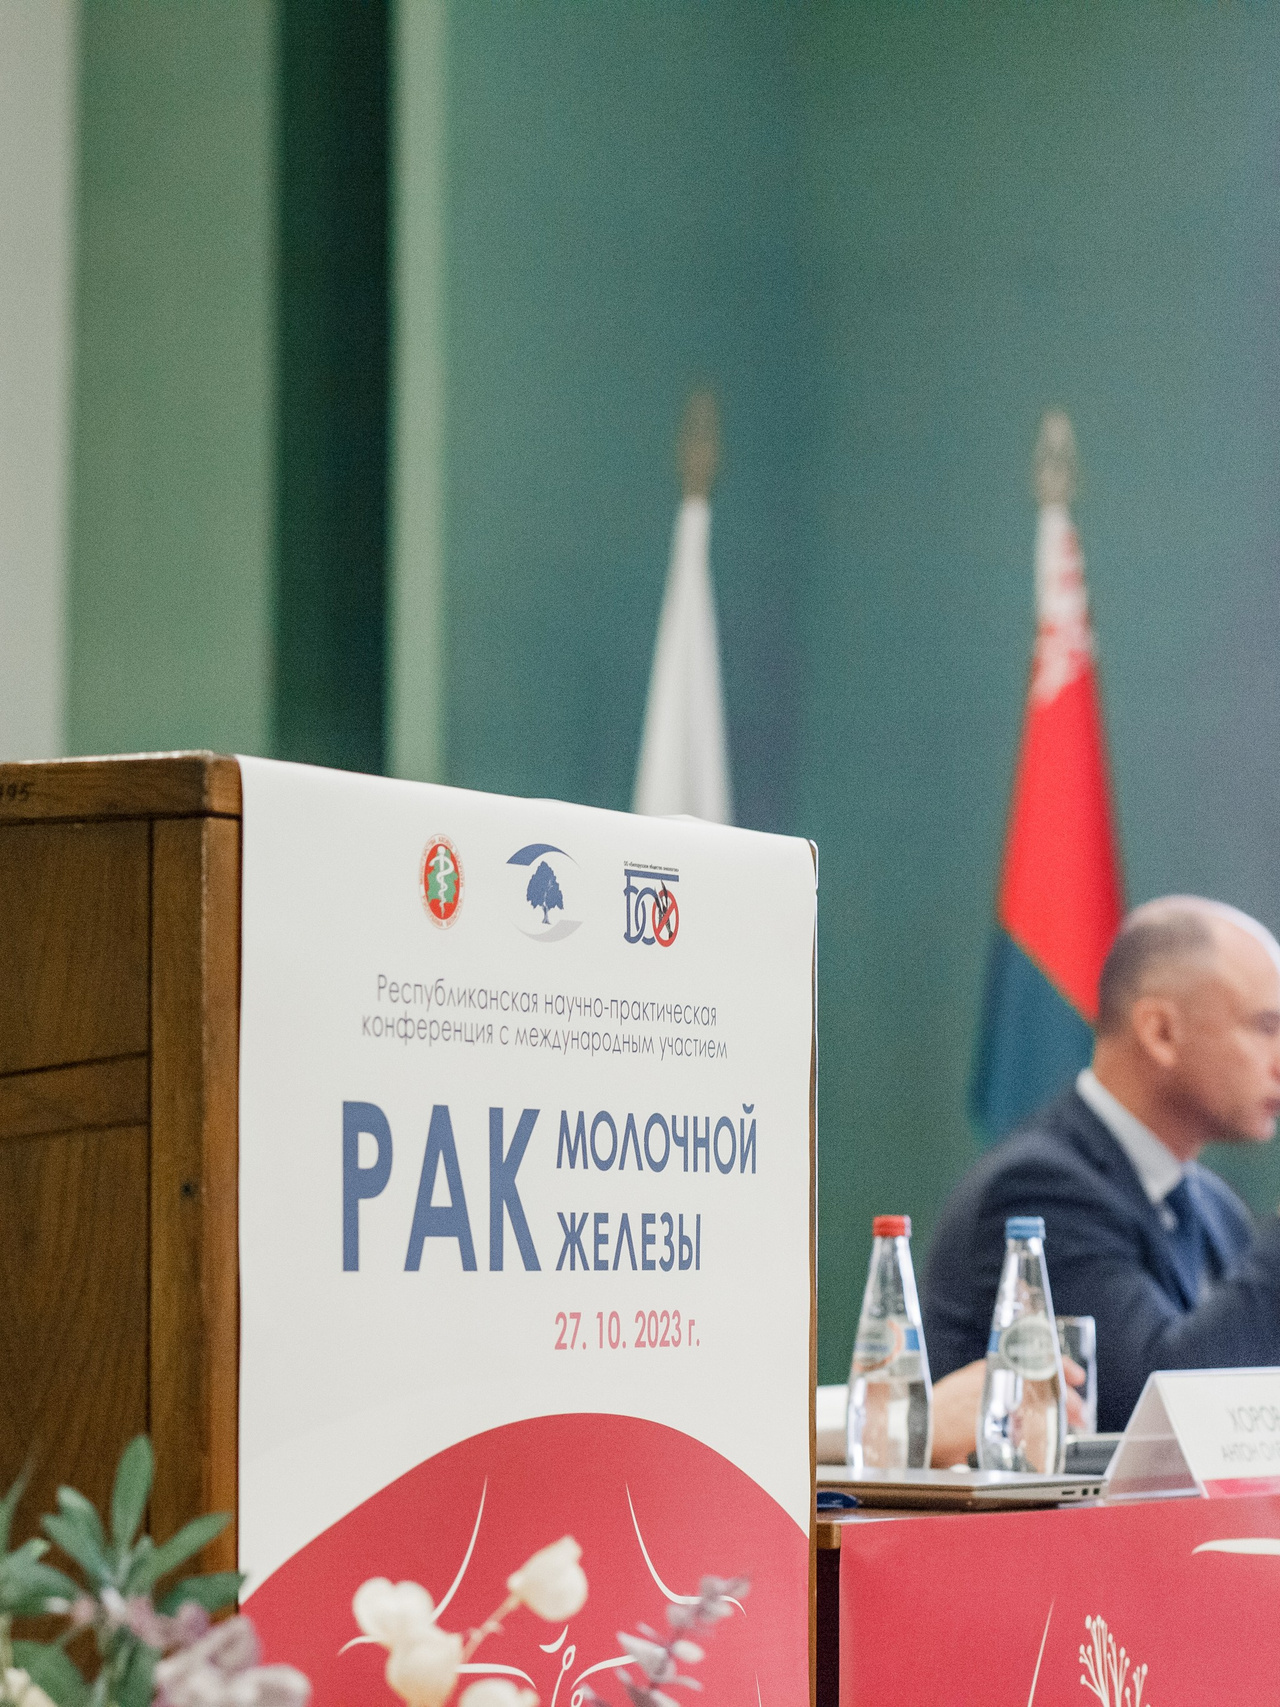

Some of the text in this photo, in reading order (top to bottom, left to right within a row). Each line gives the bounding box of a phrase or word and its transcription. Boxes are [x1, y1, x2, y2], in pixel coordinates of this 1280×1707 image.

[377, 973, 718, 1027] Республиканская научно-практическая
[361, 1010, 729, 1062] конференция с международным участием
[556, 1103, 757, 1175] МОЛОЧНОЙ
[341, 1100, 542, 1273] РАК
[555, 1212, 701, 1273] ЖЕЛЕЗЫ
[634, 1310, 682, 1349] 2023
[688, 1319, 700, 1348] г.
